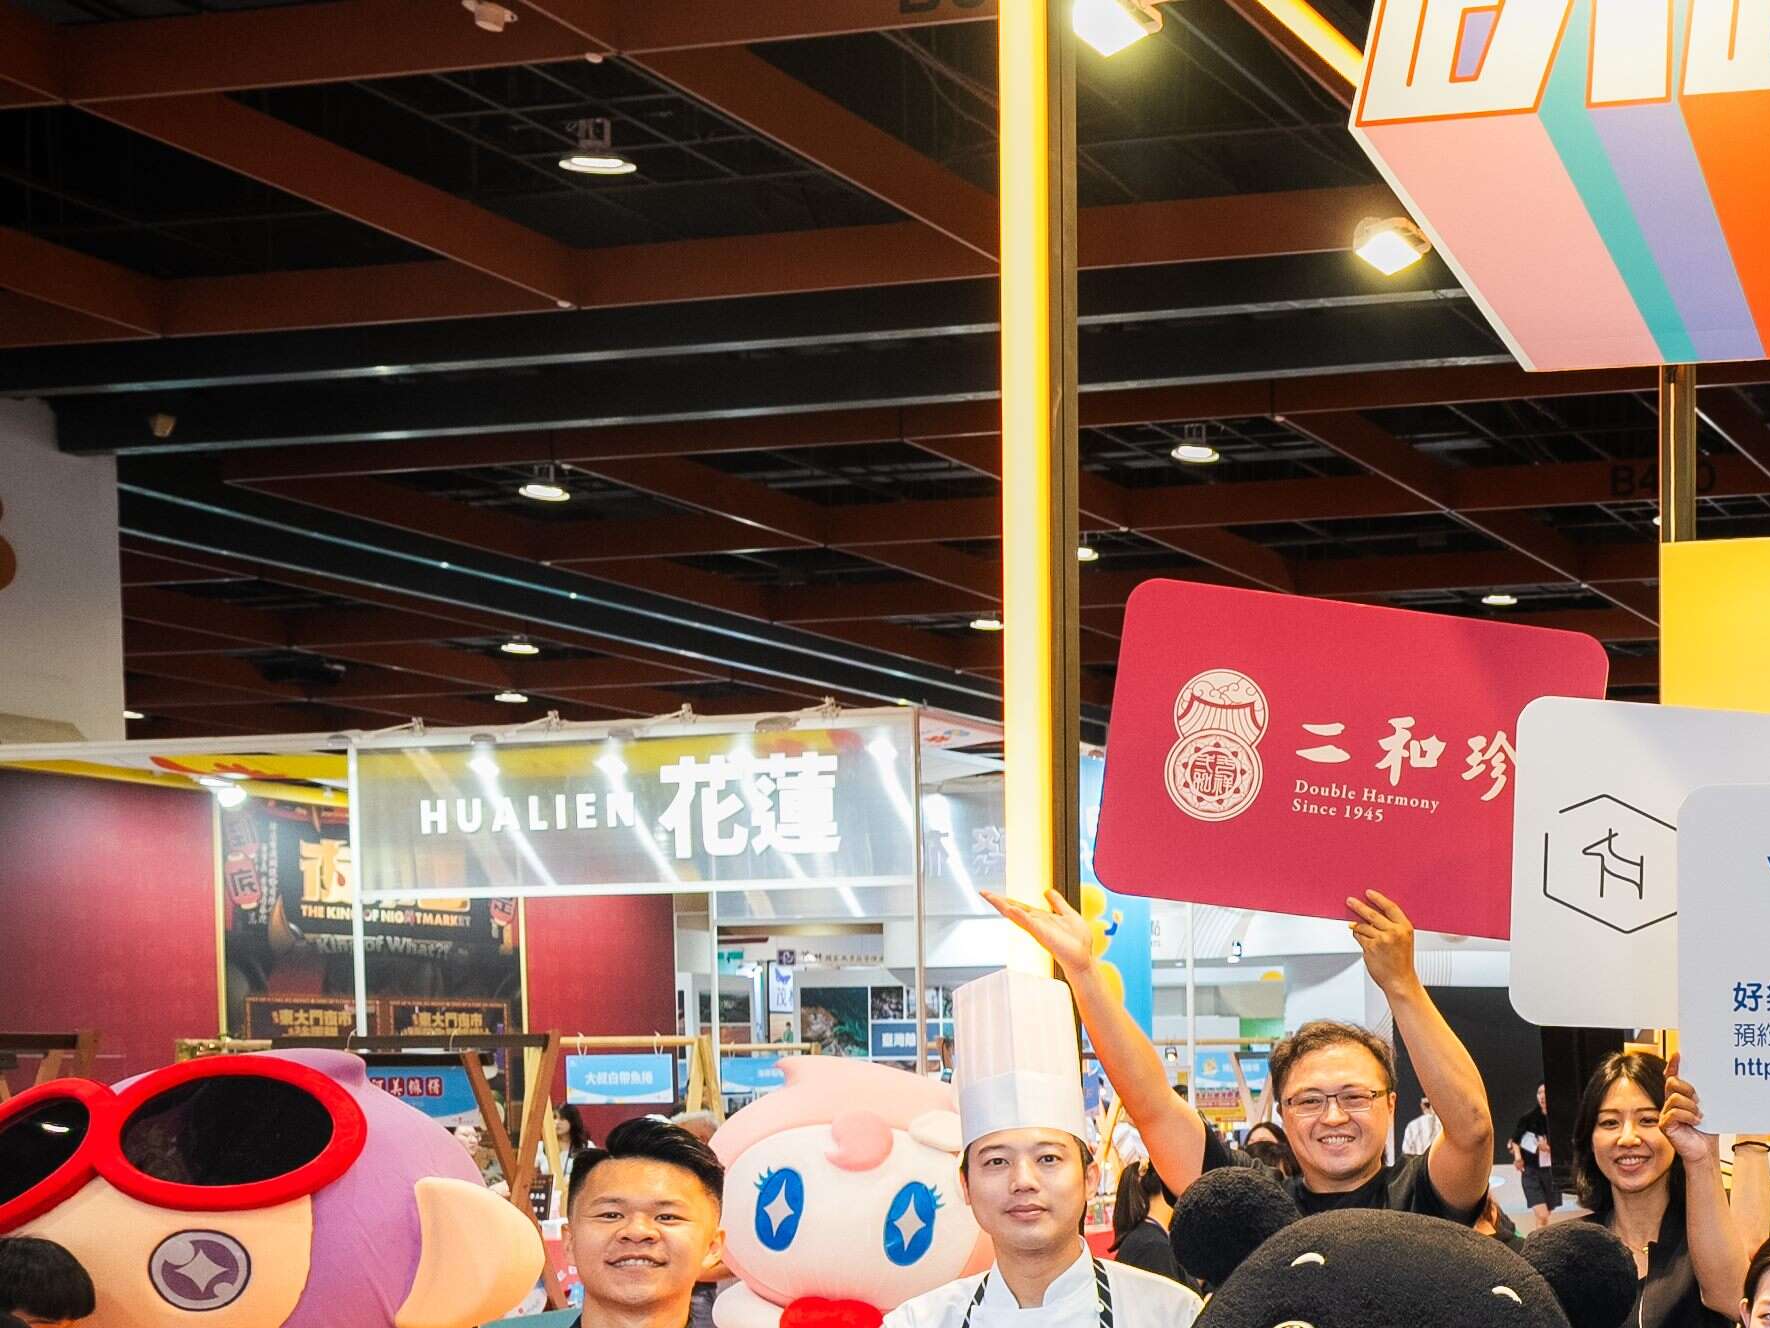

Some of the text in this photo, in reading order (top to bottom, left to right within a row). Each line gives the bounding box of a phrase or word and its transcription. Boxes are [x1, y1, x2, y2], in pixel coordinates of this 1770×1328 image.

[1296, 716, 1517, 801] 二和珍
[420, 791, 636, 835] HUALIEN
[658, 751, 842, 859] 花蓮
[1292, 799, 1384, 823] Since 1945
[1295, 779, 1440, 814] Double Harmony
[301, 905, 325, 919] THE
